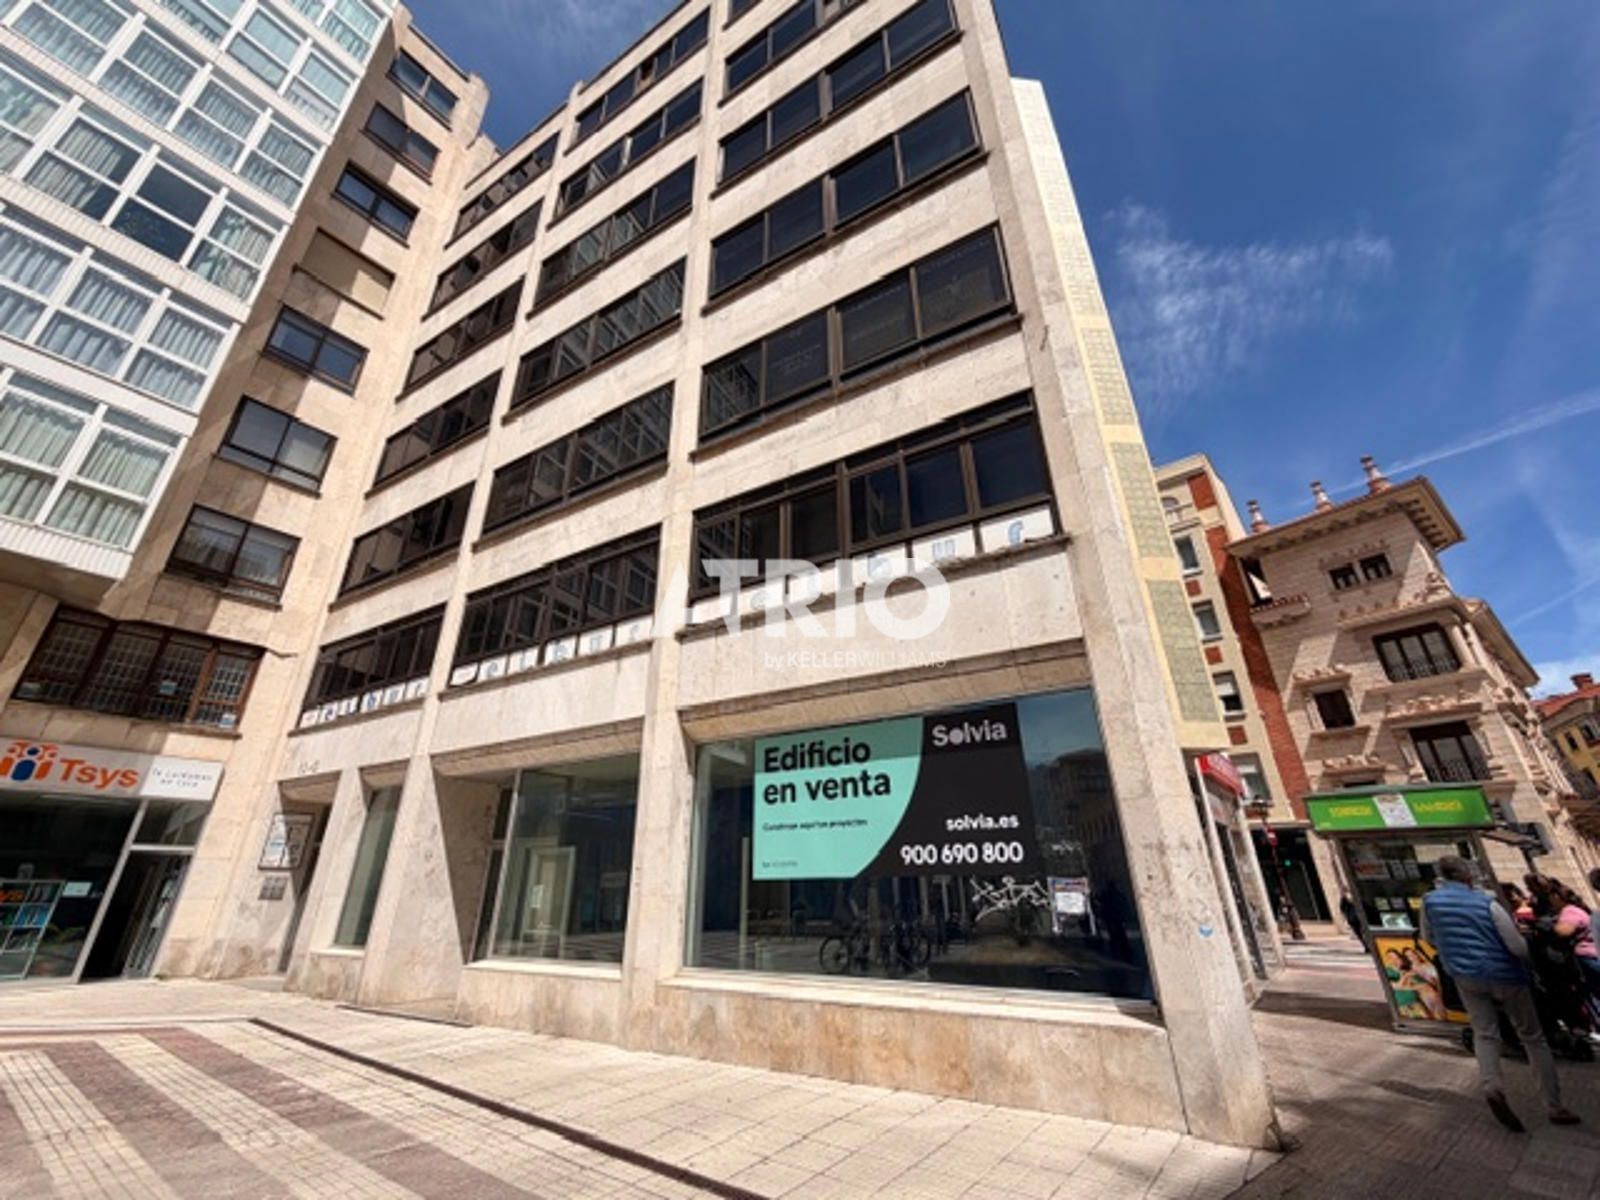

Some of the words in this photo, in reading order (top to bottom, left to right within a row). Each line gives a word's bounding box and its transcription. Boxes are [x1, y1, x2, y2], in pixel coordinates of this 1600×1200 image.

[932, 720, 1007, 747] Solvia
[763, 737, 871, 773] Edificio
[60, 758, 139, 789] Tsys
[763, 781, 796, 805] en
[805, 769, 891, 801] venta
[946, 814, 1019, 831] solvia.es
[900, 844, 937, 865] 900
[941, 842, 978, 864] 690
[981, 841, 1024, 863] 800
